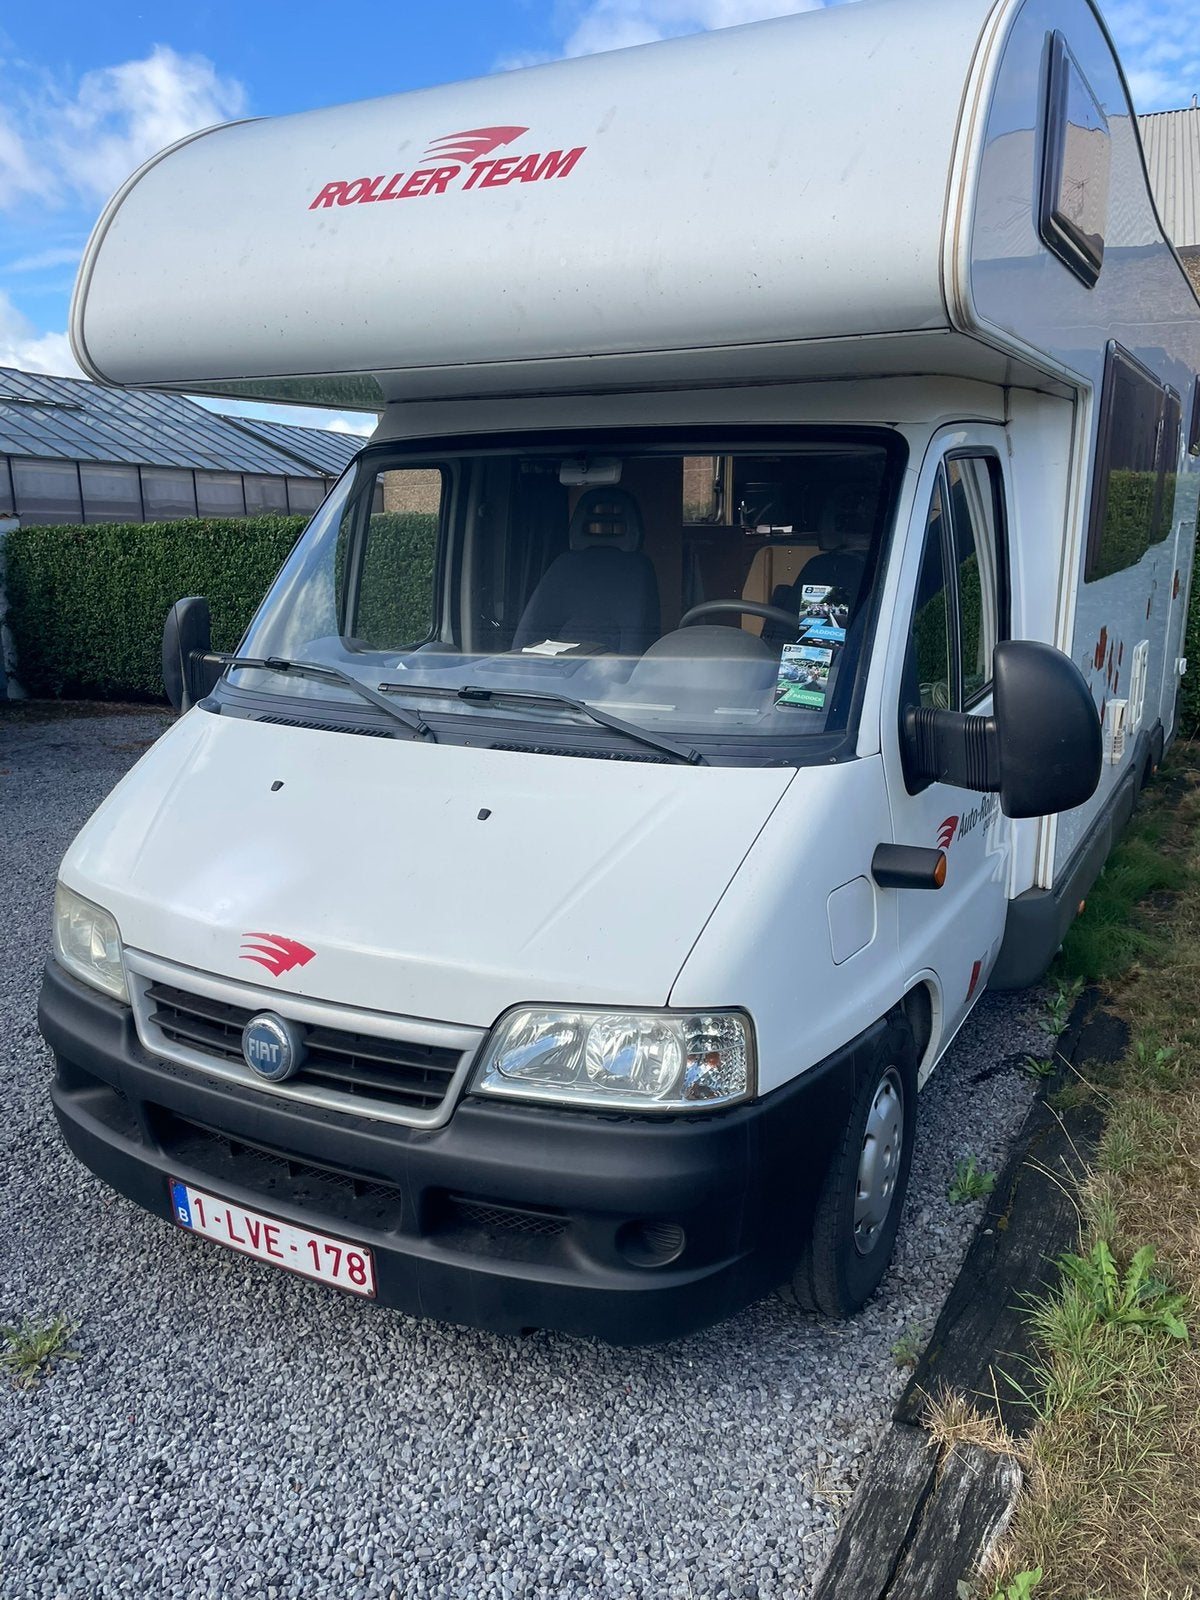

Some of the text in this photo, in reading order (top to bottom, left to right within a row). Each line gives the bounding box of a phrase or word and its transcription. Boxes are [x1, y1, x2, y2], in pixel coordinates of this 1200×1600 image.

[309, 146, 587, 209] ROLLER TEAM
[810, 628, 844, 636] PADDOCK
[793, 693, 822, 701] PADDOCK
[249, 1038, 279, 1063] FIAT
[178, 1206, 189, 1222] B
